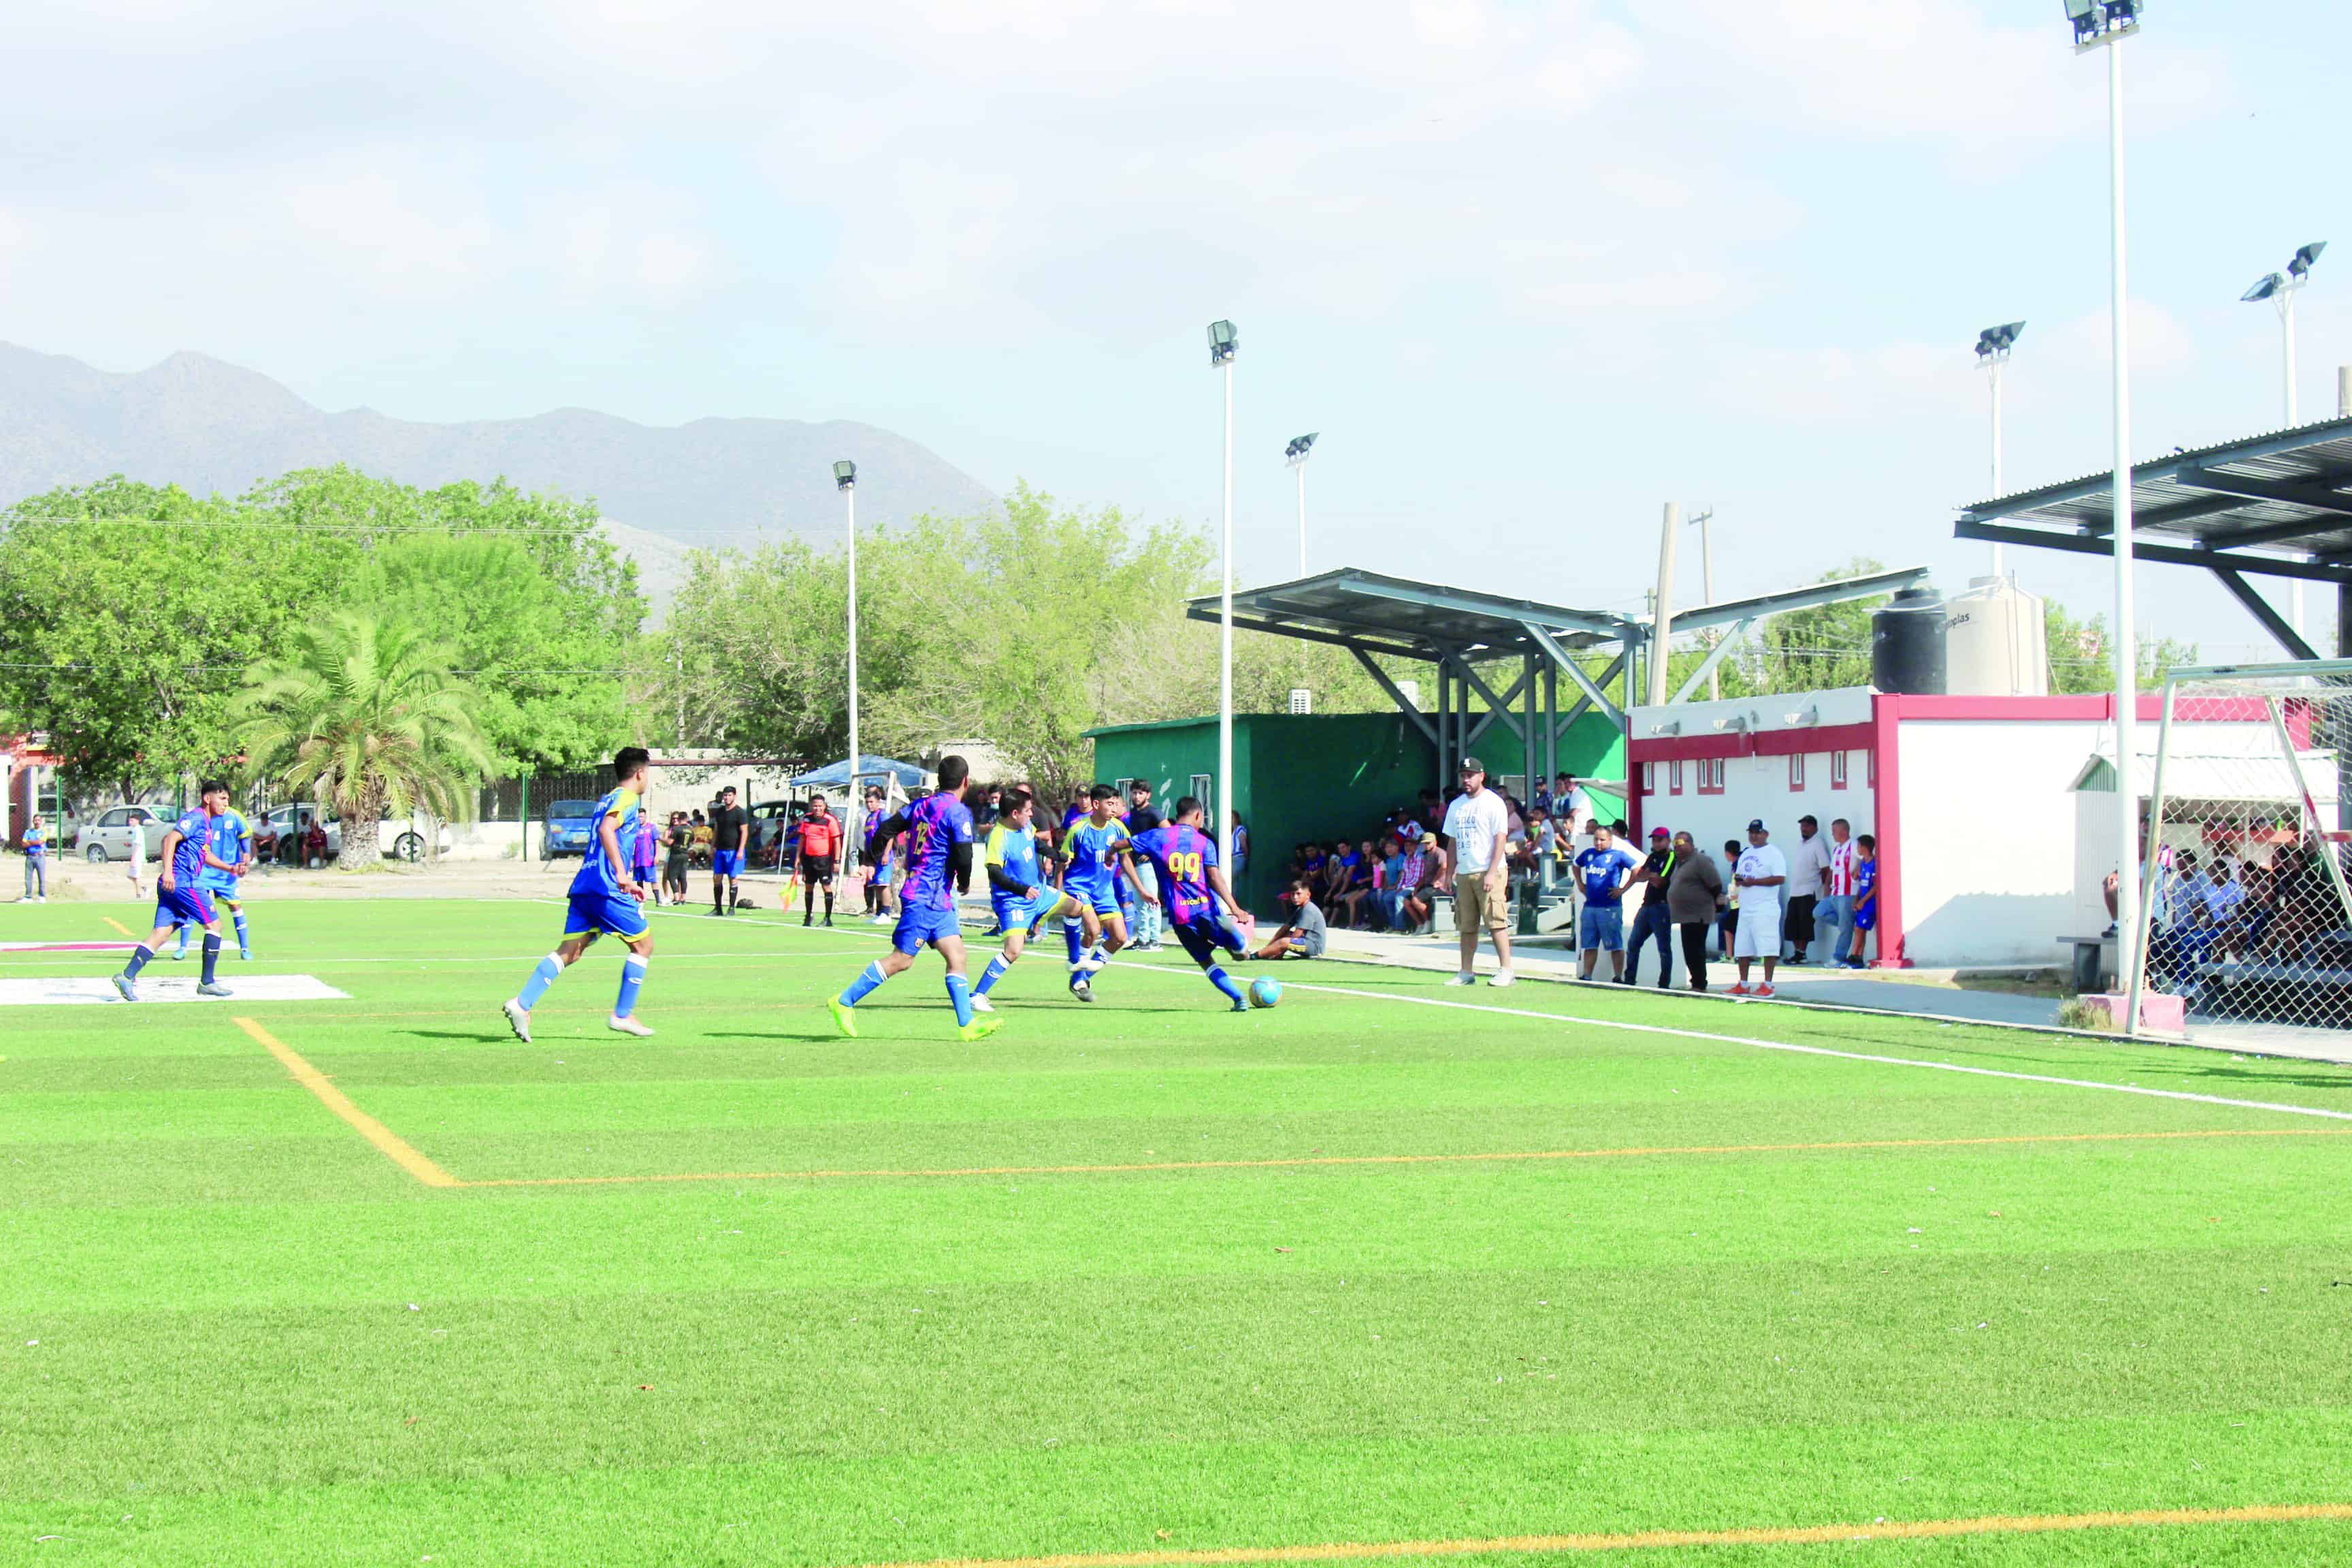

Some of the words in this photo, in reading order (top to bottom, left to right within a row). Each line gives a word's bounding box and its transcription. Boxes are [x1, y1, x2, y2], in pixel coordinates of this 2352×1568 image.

[1022, 846, 1034, 863] 10
[1169, 851, 1200, 883] 99
[1586, 864, 1606, 877] Jeep
[1011, 909, 1024, 921] 10
